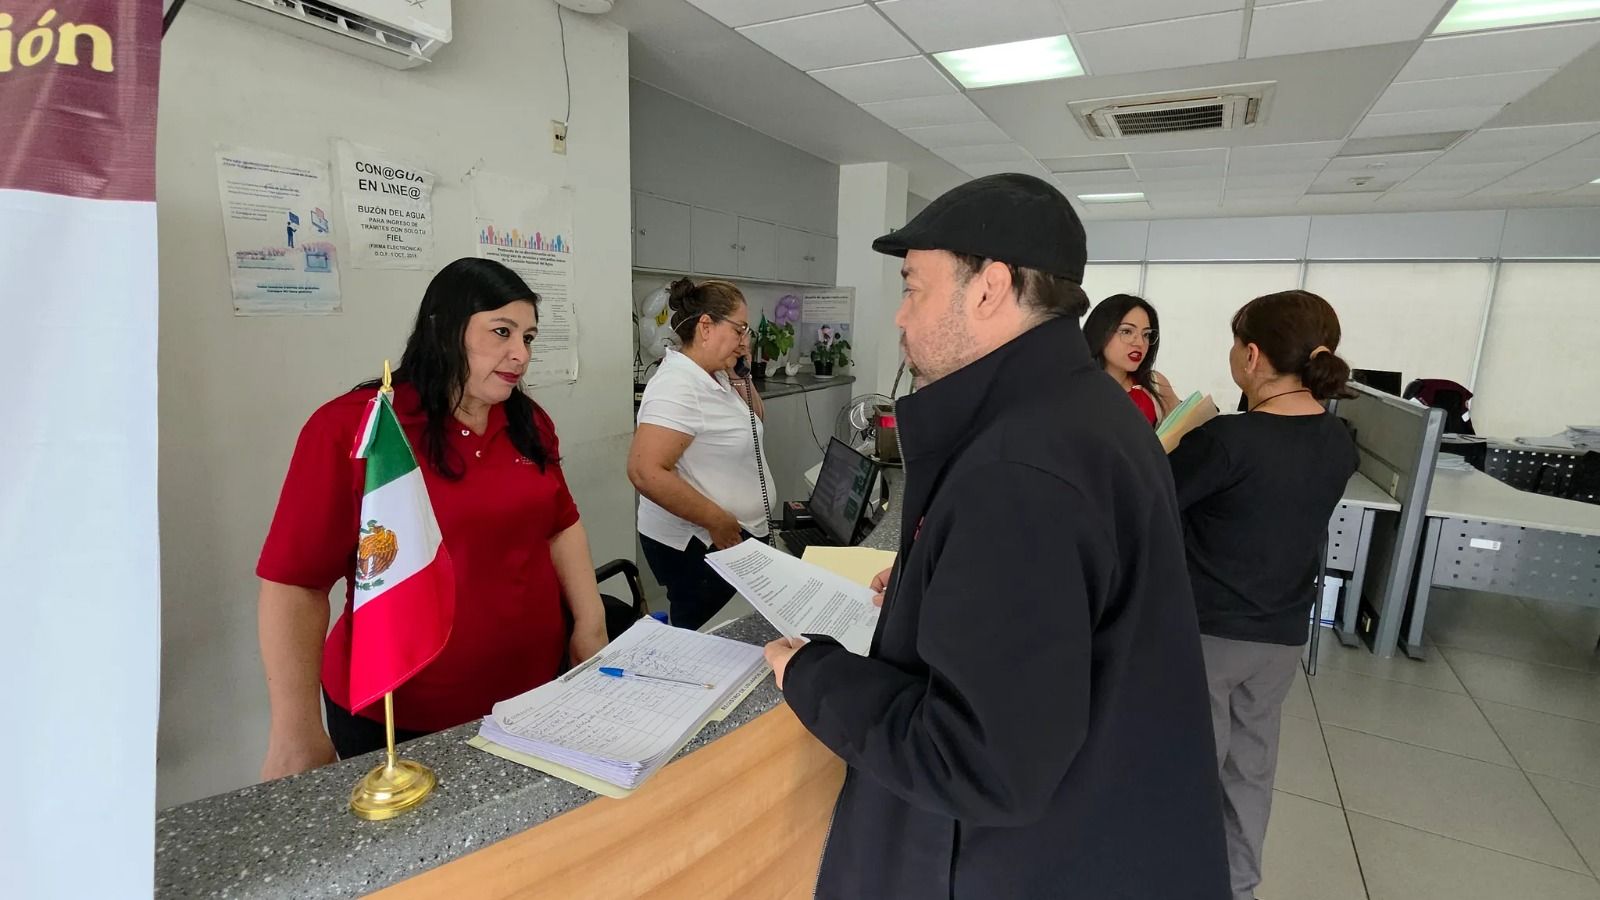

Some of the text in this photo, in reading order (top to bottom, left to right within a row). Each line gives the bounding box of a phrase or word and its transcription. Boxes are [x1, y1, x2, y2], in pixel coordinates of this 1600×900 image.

[0, 9, 114, 72] ión
[355, 161, 424, 183] CON@GUA
[359, 179, 421, 200] EN LINE@
[389, 208, 404, 217] DEL
[406, 211, 425, 220] AGUA
[386, 218, 410, 227] INGRESO
[386, 234, 404, 242] FIEL
